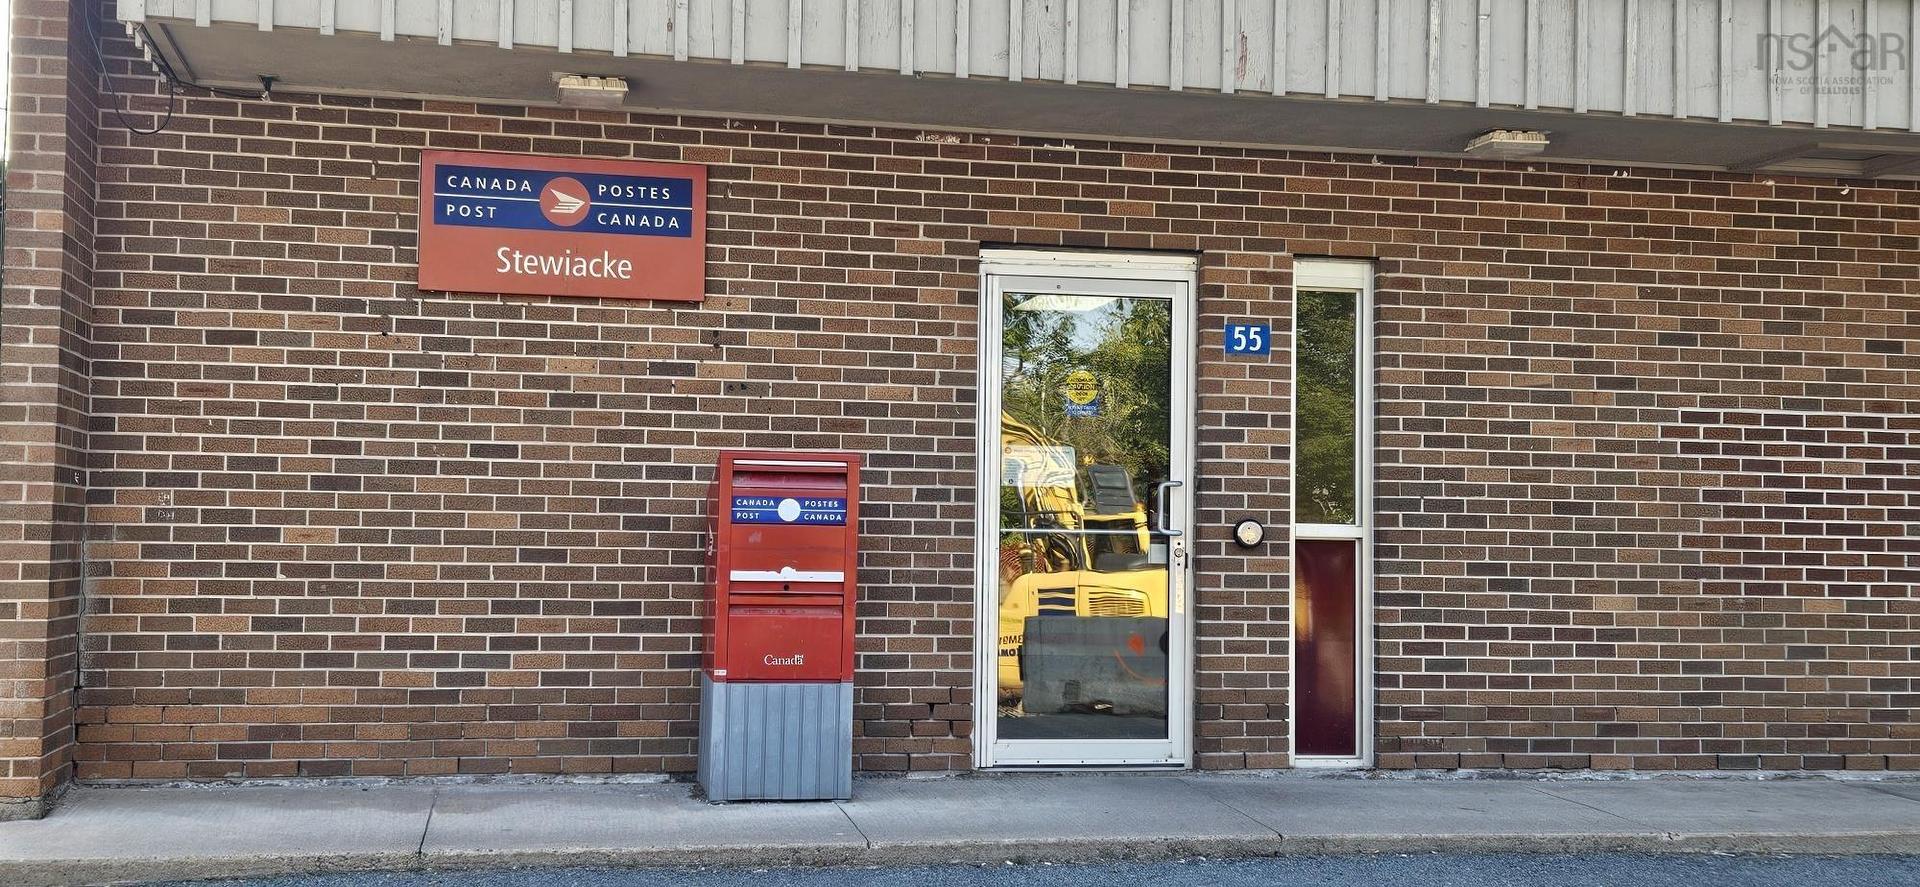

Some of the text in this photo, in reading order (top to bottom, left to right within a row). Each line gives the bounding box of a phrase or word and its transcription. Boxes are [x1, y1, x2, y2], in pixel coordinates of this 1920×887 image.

[447, 175, 532, 192] CANADA
[598, 184, 671, 200] POSTES
[446, 204, 497, 219] POST
[597, 213, 680, 229] CANADA
[496, 246, 633, 279] Stewiacke
[1233, 326, 1262, 351] 55
[804, 500, 838, 508] POSTES
[803, 513, 842, 521] CANADA
[764, 654, 804, 666] Canada
